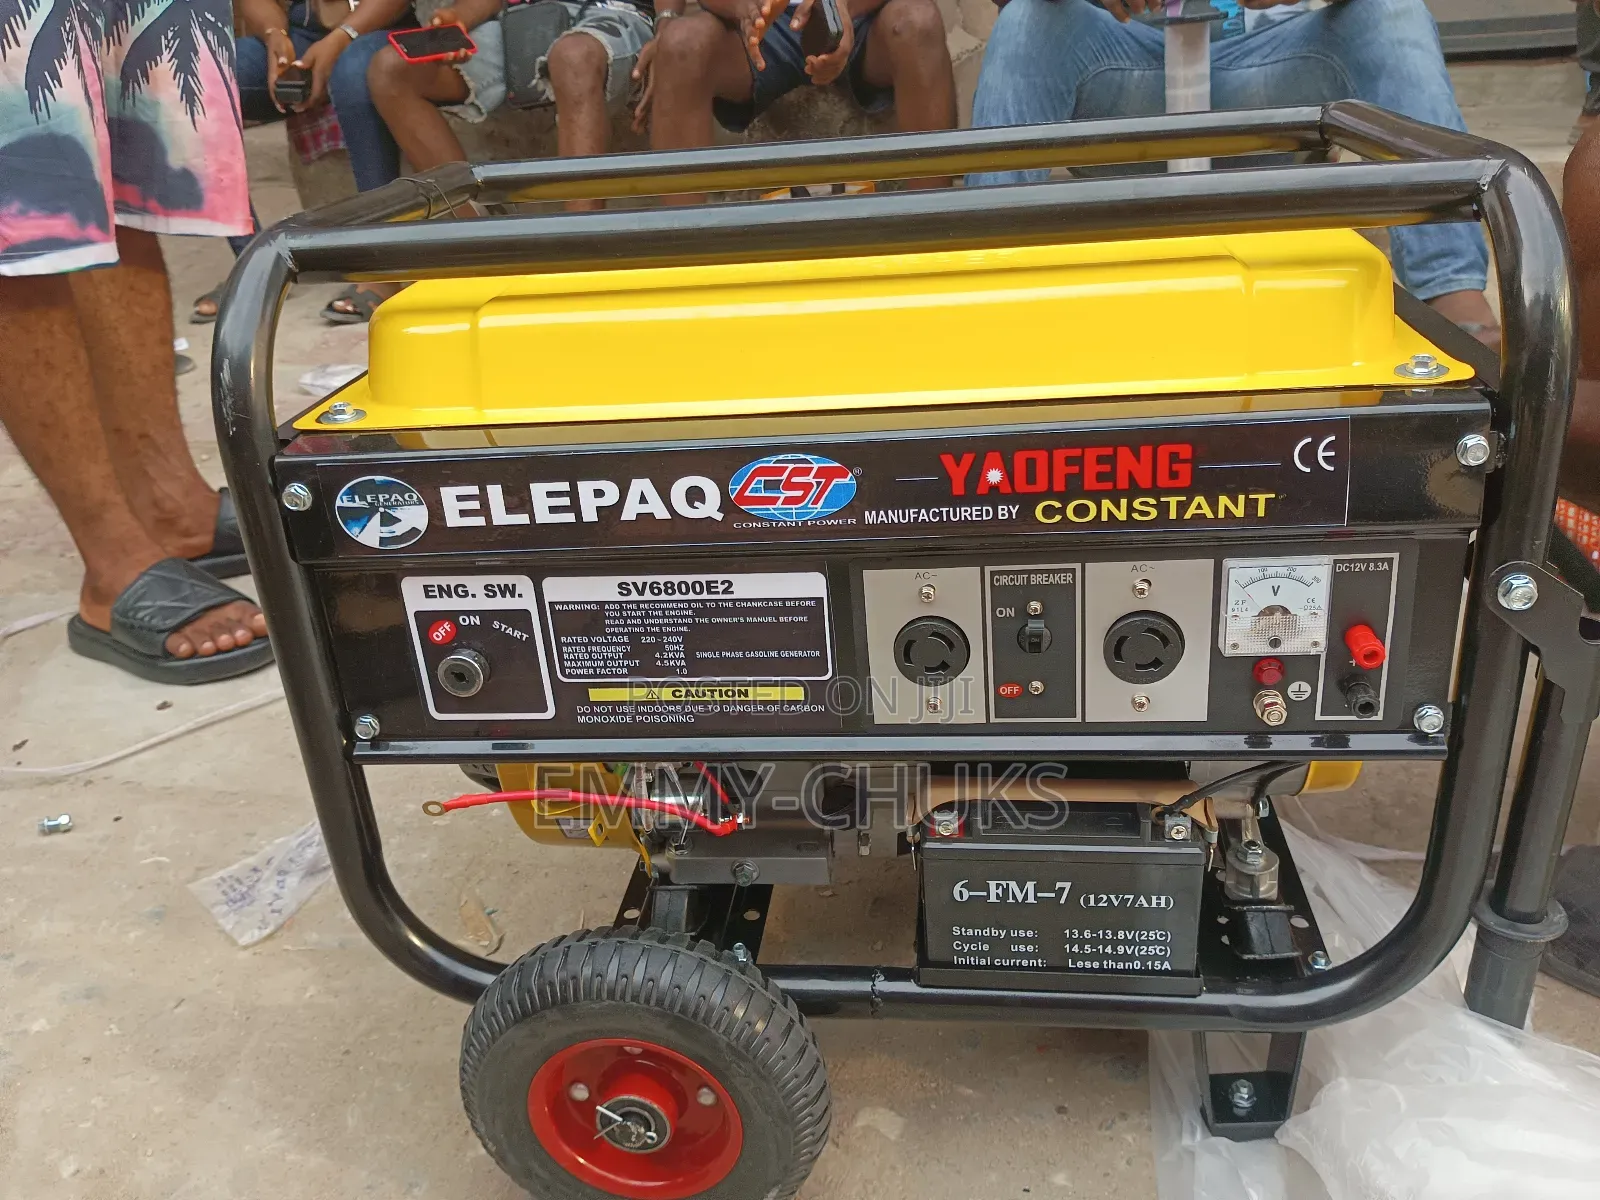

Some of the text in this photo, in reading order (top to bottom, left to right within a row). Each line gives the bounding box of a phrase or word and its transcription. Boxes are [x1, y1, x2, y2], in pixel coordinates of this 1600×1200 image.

[939, 443, 1194, 496] YAOFENG
[732, 463, 852, 509] CST
[342, 492, 419, 505] ELEPAQ
[440, 475, 725, 528] ELEPAQ
[864, 493, 1276, 525] MANUFACTURED BY CONSTANT
[733, 518, 857, 529] CONSTANT POWER
[1336, 562, 1390, 572] DC12V 8.3A
[993, 573, 1074, 586] CIRCUIT BREAKER
[422, 583, 524, 599] ENG. SW.
[617, 580, 735, 597] SV6800E2
[1272, 585, 1281, 597] V
[554, 603, 600, 611] WARNING:
[639, 602, 689, 610] RECOMMEND
[996, 607, 1015, 618] ON
[458, 615, 481, 626] ON
[432, 621, 452, 641] OFF
[492, 620, 530, 642] START
[591, 635, 630, 643] VOLTAGE
[588, 645, 631, 653] FREQUENCY
[665, 644, 685, 652] 50HZ
[696, 651, 720, 659] SINGLE
[780, 650, 821, 658] GENERATOR
[564, 660, 605, 668] MAXIMUM
[671, 688, 750, 699] CAUTION
[1000, 686, 1020, 695] OFF
[576, 704, 825, 713] DO NOT USE INDOORS DUE TO DANGER OF CARBON
[577, 715, 695, 724] MONOXIDE POISONING
[1079, 893, 1175, 911] (12V7AH)
[952, 926, 1007, 939] Standby
[1010, 929, 1039, 938] use:
[953, 941, 990, 953] Cycle
[1010, 944, 1039, 953] use:
[953, 955, 991, 966] Initial
[994, 958, 1047, 968] current:
[1068, 958, 1100, 969] Lese
